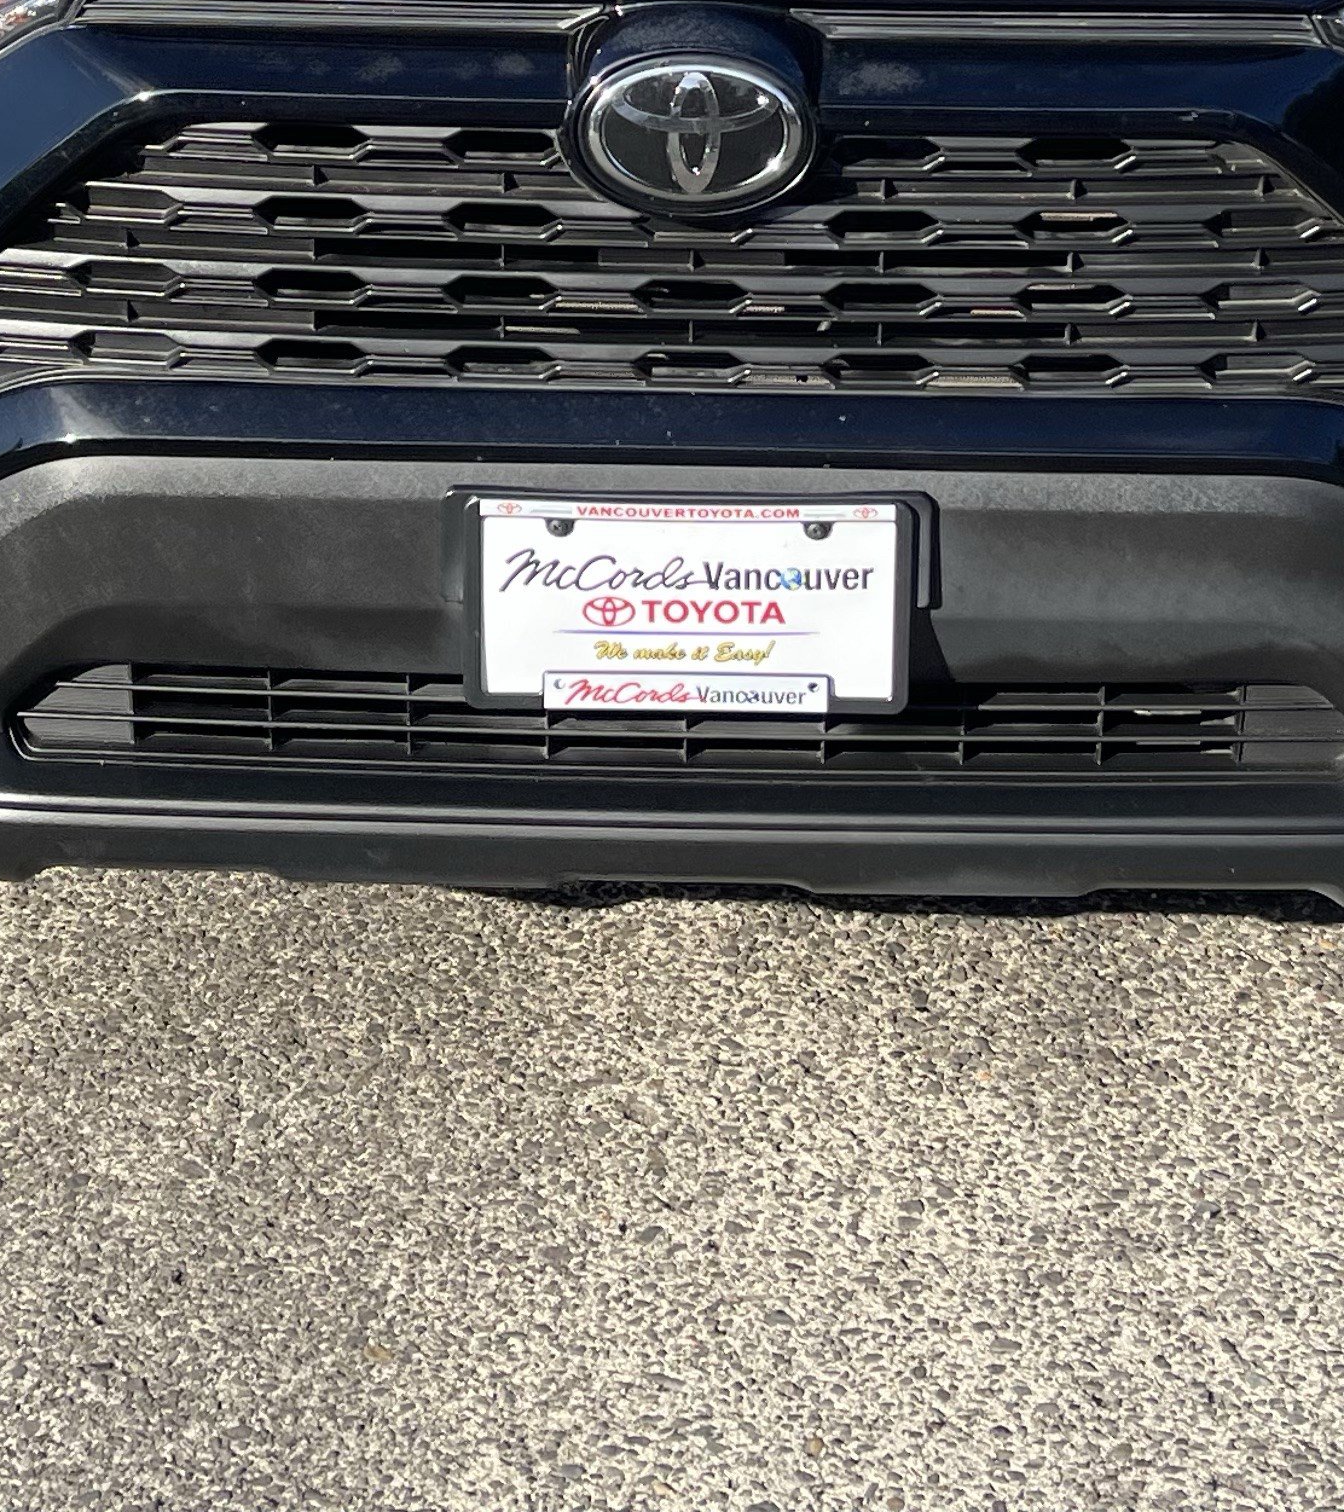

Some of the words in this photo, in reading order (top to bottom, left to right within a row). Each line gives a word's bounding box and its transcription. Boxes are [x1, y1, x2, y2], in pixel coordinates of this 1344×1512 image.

[576, 505, 800, 519] VANCOUVERTOYOTA.COM
[641, 600, 786, 625] TOYOTA
[593, 639, 629, 661] We
[632, 642, 687, 662] make
[690, 644, 710, 662] it
[713, 639, 777, 666] Easy!
